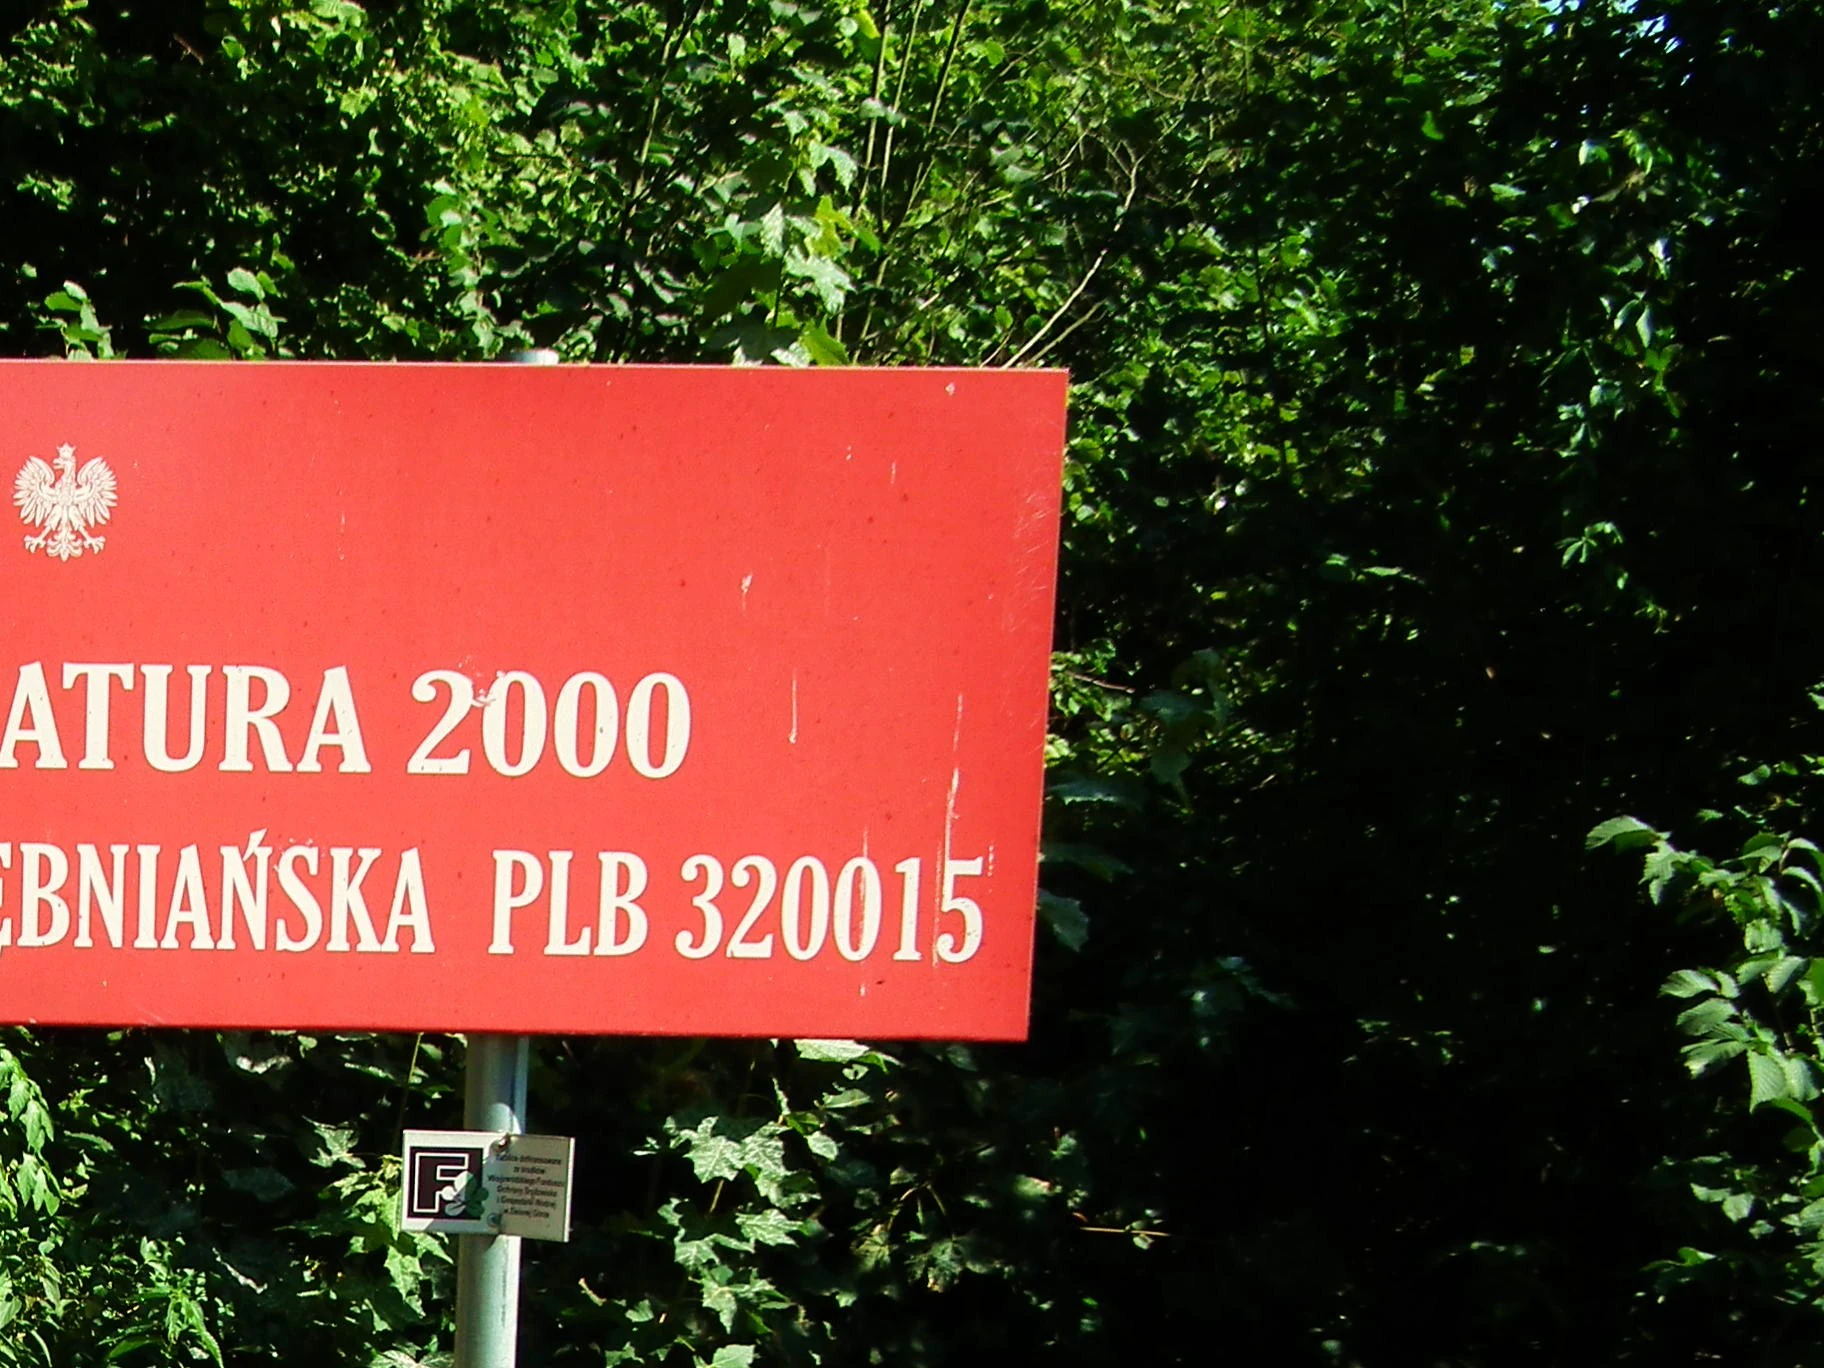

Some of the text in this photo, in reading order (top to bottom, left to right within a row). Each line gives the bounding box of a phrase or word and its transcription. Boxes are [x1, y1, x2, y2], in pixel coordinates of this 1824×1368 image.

[407, 668, 692, 778] 2000
[488, 849, 649, 957] PLB
[675, 854, 985, 963] 320015
